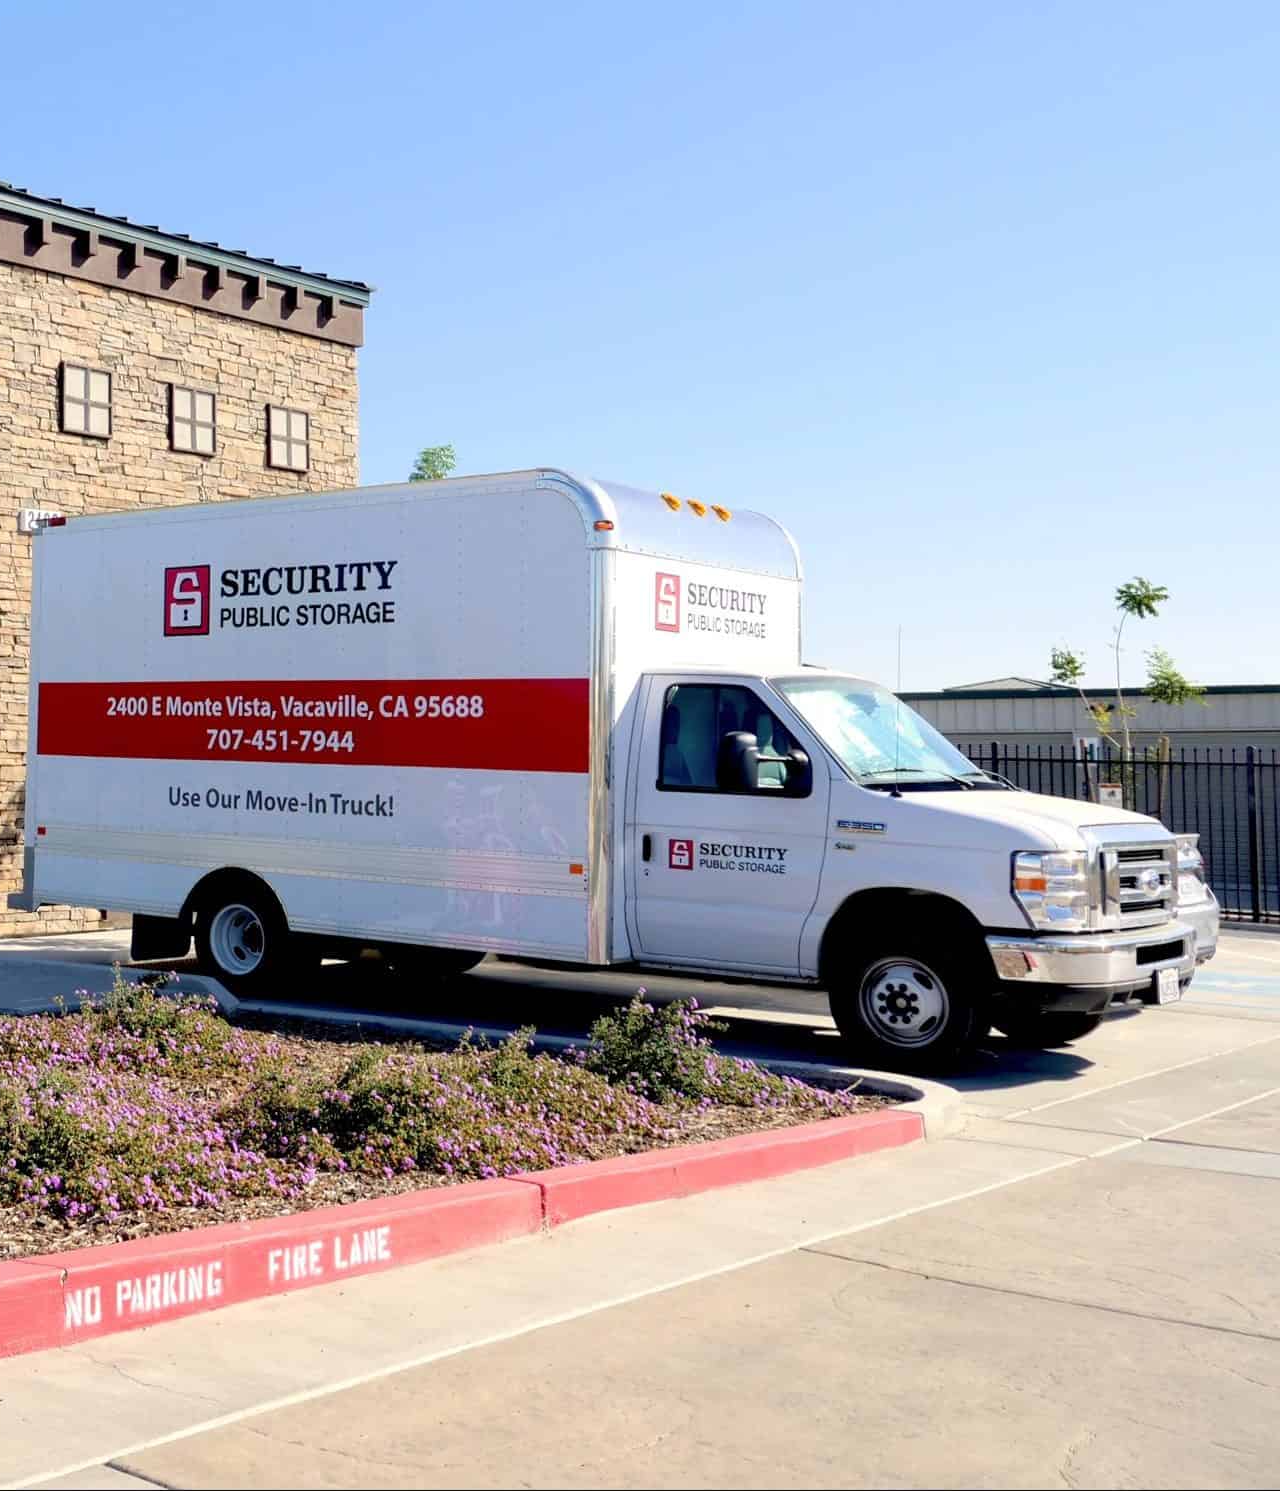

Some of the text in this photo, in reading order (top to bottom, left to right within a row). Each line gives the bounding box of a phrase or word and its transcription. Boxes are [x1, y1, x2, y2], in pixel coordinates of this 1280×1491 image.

[220, 561, 398, 598] SECURITY
[687, 582, 767, 615] SECURITY
[220, 602, 395, 628] PUBLIC STORAGE
[687, 613, 766, 639] PUBLIC STORAGE
[107, 695, 484, 720] 2400 E Monte Vista, Vacaville, CA 95688
[207, 729, 354, 752] 707-451-7944
[169, 786, 394, 817] Use Our Move-In Truck!
[699, 842, 788, 860] SECURITY
[699, 858, 786, 874] PUBLIC STORAGE
[269, 1227, 391, 1281] FIRE LANE
[65, 1261, 224, 1328] NO PARKING
